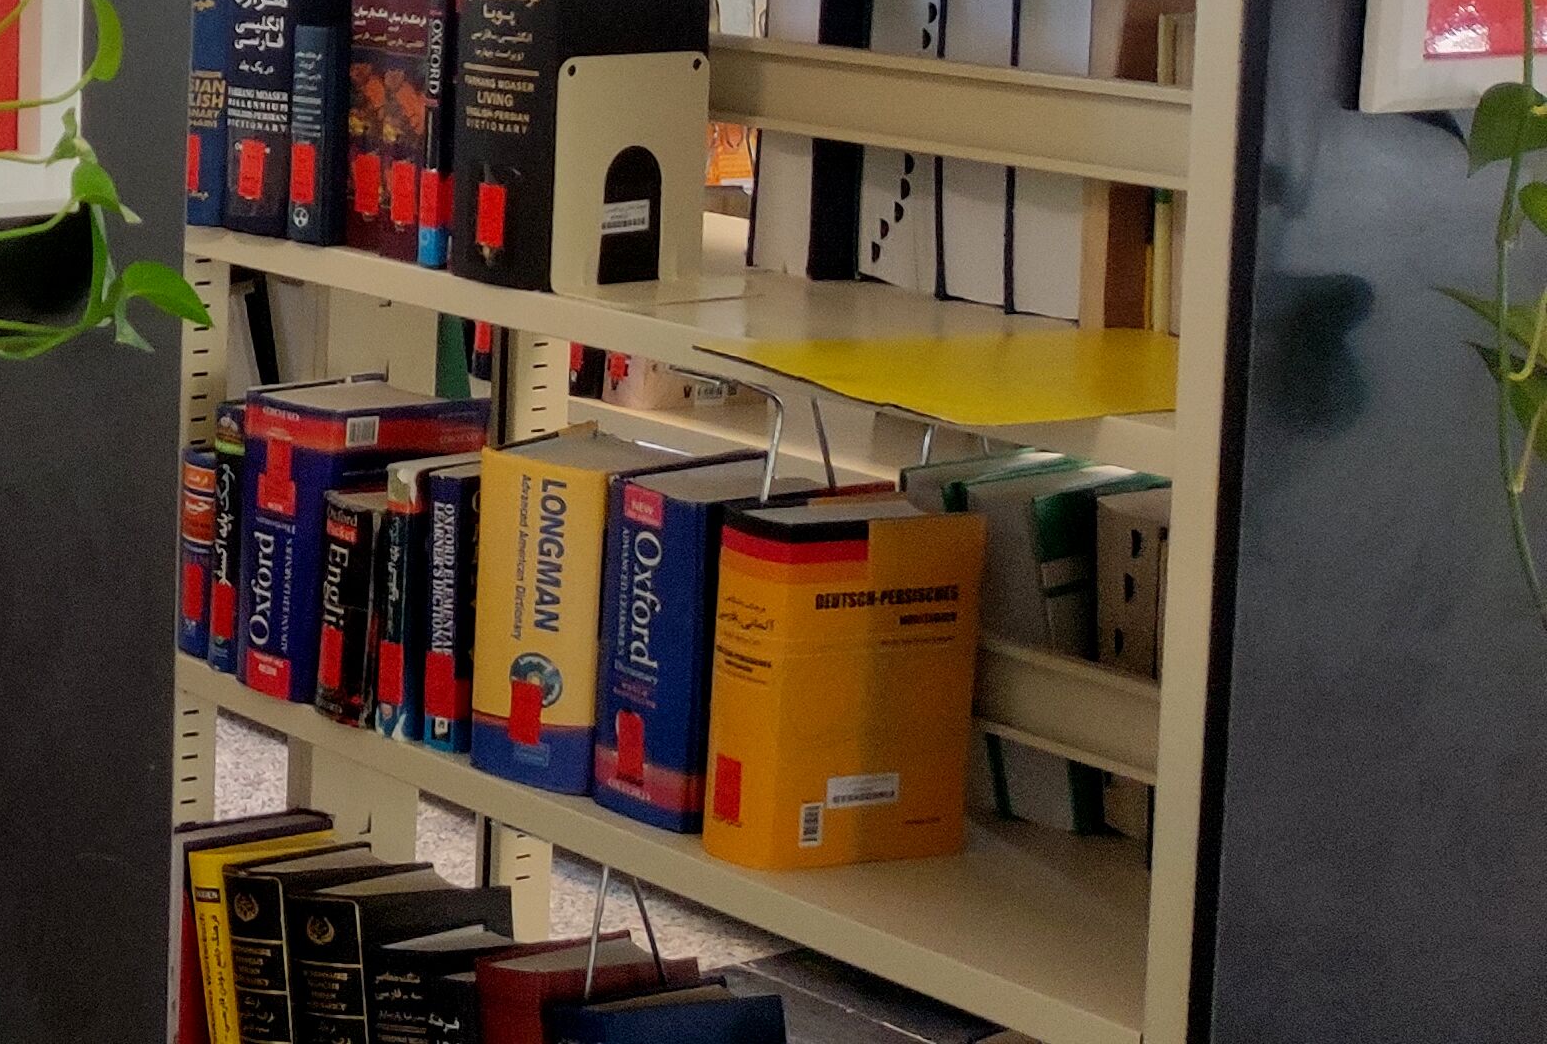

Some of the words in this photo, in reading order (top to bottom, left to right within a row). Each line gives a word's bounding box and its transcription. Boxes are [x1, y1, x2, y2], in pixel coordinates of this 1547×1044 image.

[234, 15, 285, 34] انگلیسی
[234, 32, 284, 52] فارسی
[482, 3, 516, 26] پویا
[428, 19, 444, 95] OXFORD
[477, 90, 514, 108] LIVING
[498, 79, 535, 92] MOASER
[226, 117, 288, 133] DICTIONARY
[465, 118, 529, 135] DICTIONARY
[519, 474, 532, 528] Advanced
[444, 503, 456, 566] OXFORD
[516, 529, 529, 582] American
[533, 477, 568, 633] LONGMAN
[248, 530, 275, 646] Oxford
[323, 543, 350, 627] Engli
[442, 567, 455, 657] ELEMENTA
[511, 584, 527, 641] Dictionary
[629, 532, 663, 670] Oxford
[431, 579, 443, 654] DICTIONA
